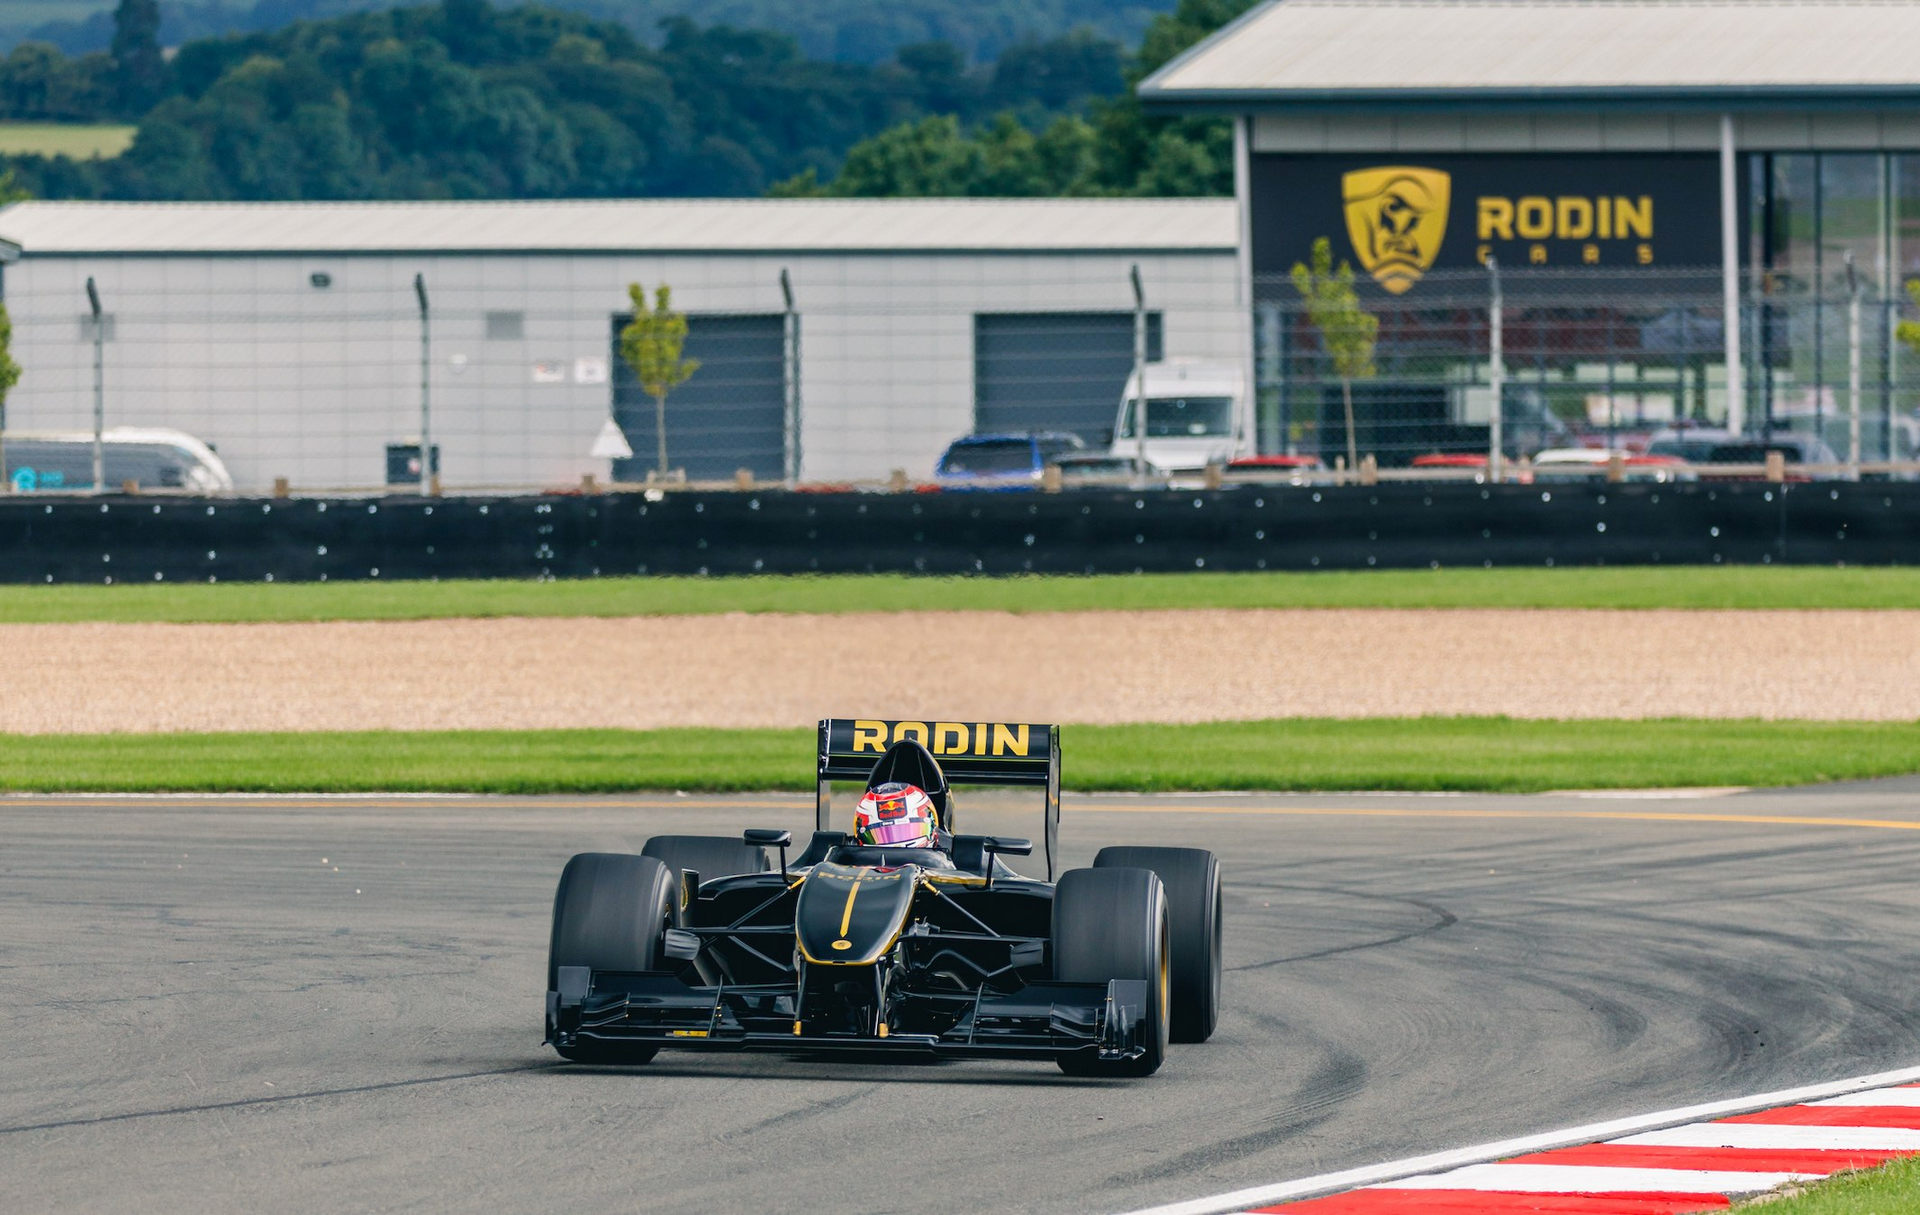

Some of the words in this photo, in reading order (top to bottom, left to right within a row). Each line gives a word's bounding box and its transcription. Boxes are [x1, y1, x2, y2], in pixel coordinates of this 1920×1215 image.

[1476, 195, 1654, 240] RODIN
[1476, 244, 1654, 264] CARS
[852, 719, 1030, 756] RODIN
